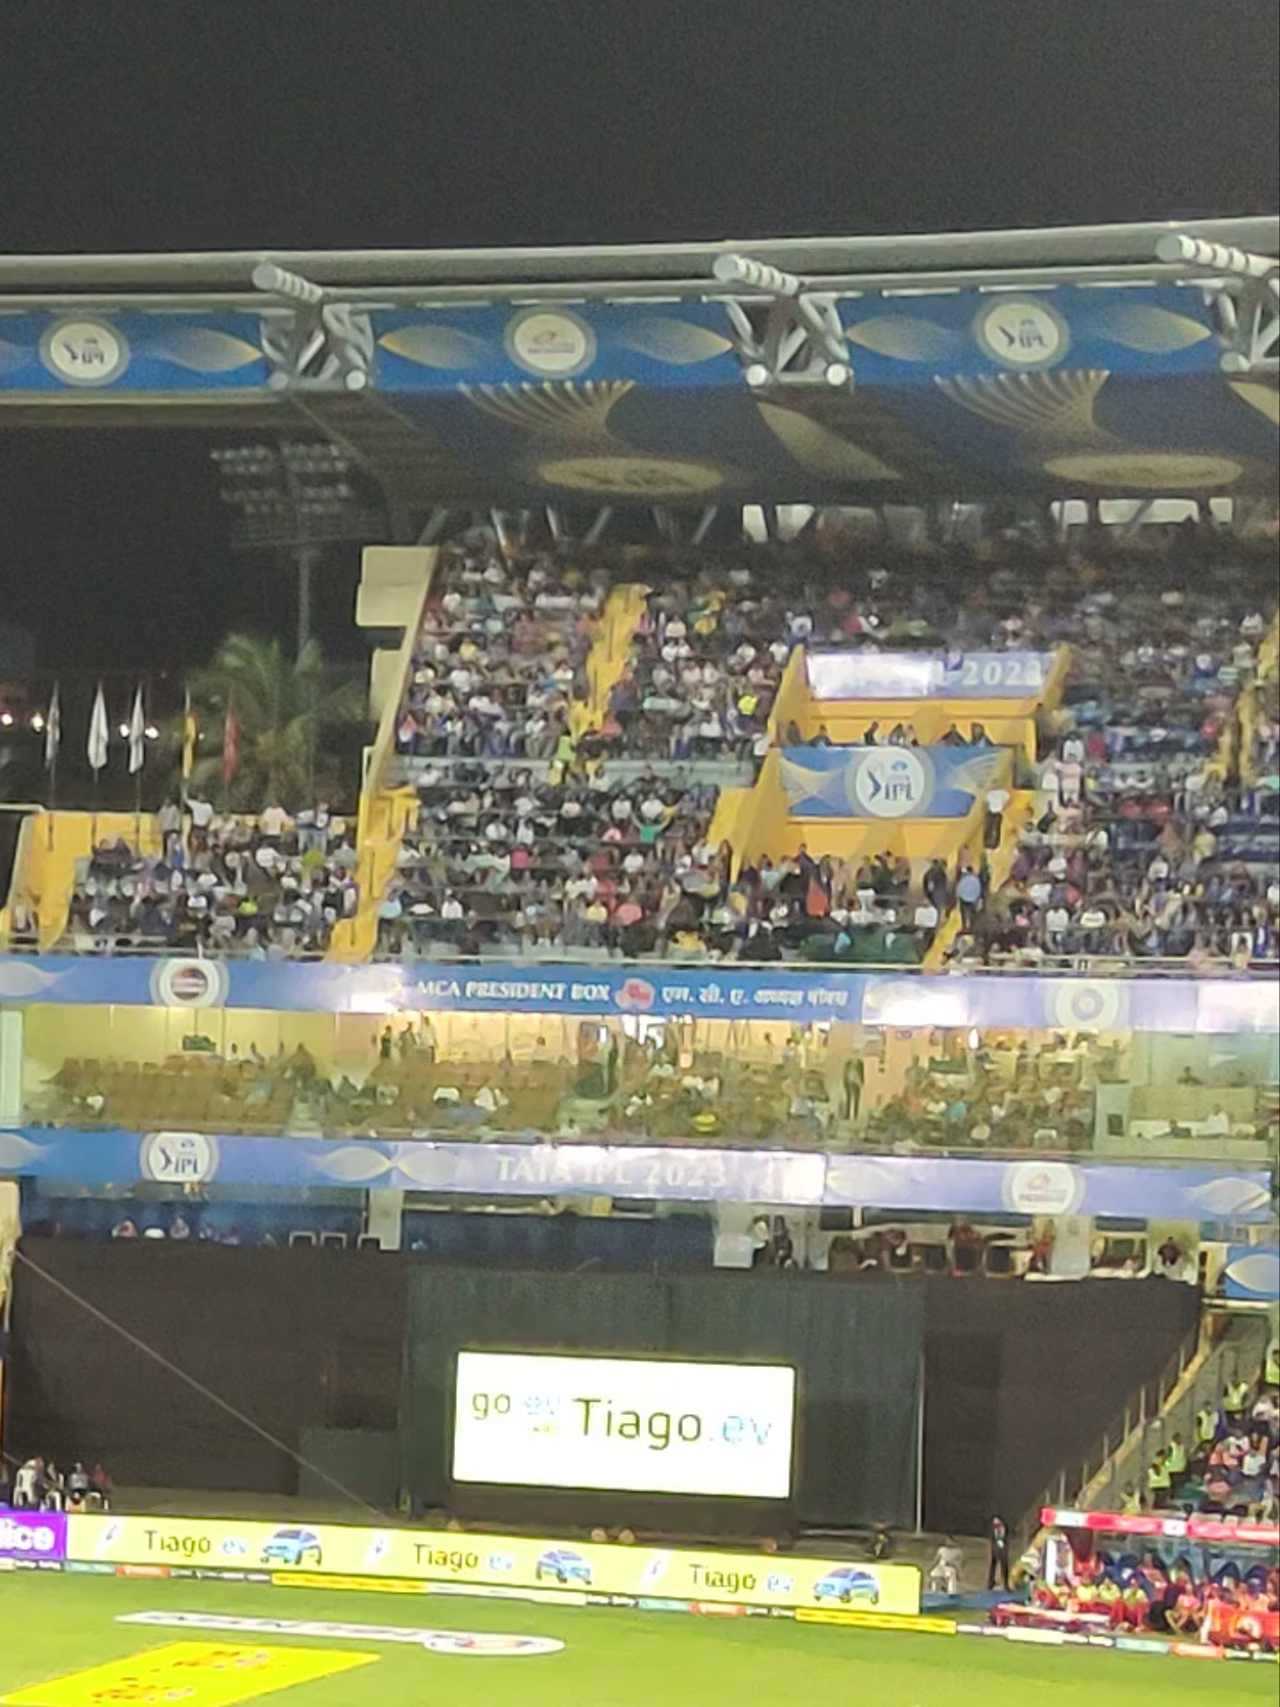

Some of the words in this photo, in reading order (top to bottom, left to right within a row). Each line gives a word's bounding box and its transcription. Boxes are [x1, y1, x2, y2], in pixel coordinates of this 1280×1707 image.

[465, 981, 566, 1001] PRESIDENT
[570, 983, 611, 1001] BOX
[646, 1160, 728, 1187] 2023
[472, 1392, 511, 1420] go
[145, 1530, 211, 1557] Tiago
[413, 1543, 479, 1571] Tiago
[689, 1564, 756, 1593] Tiago
